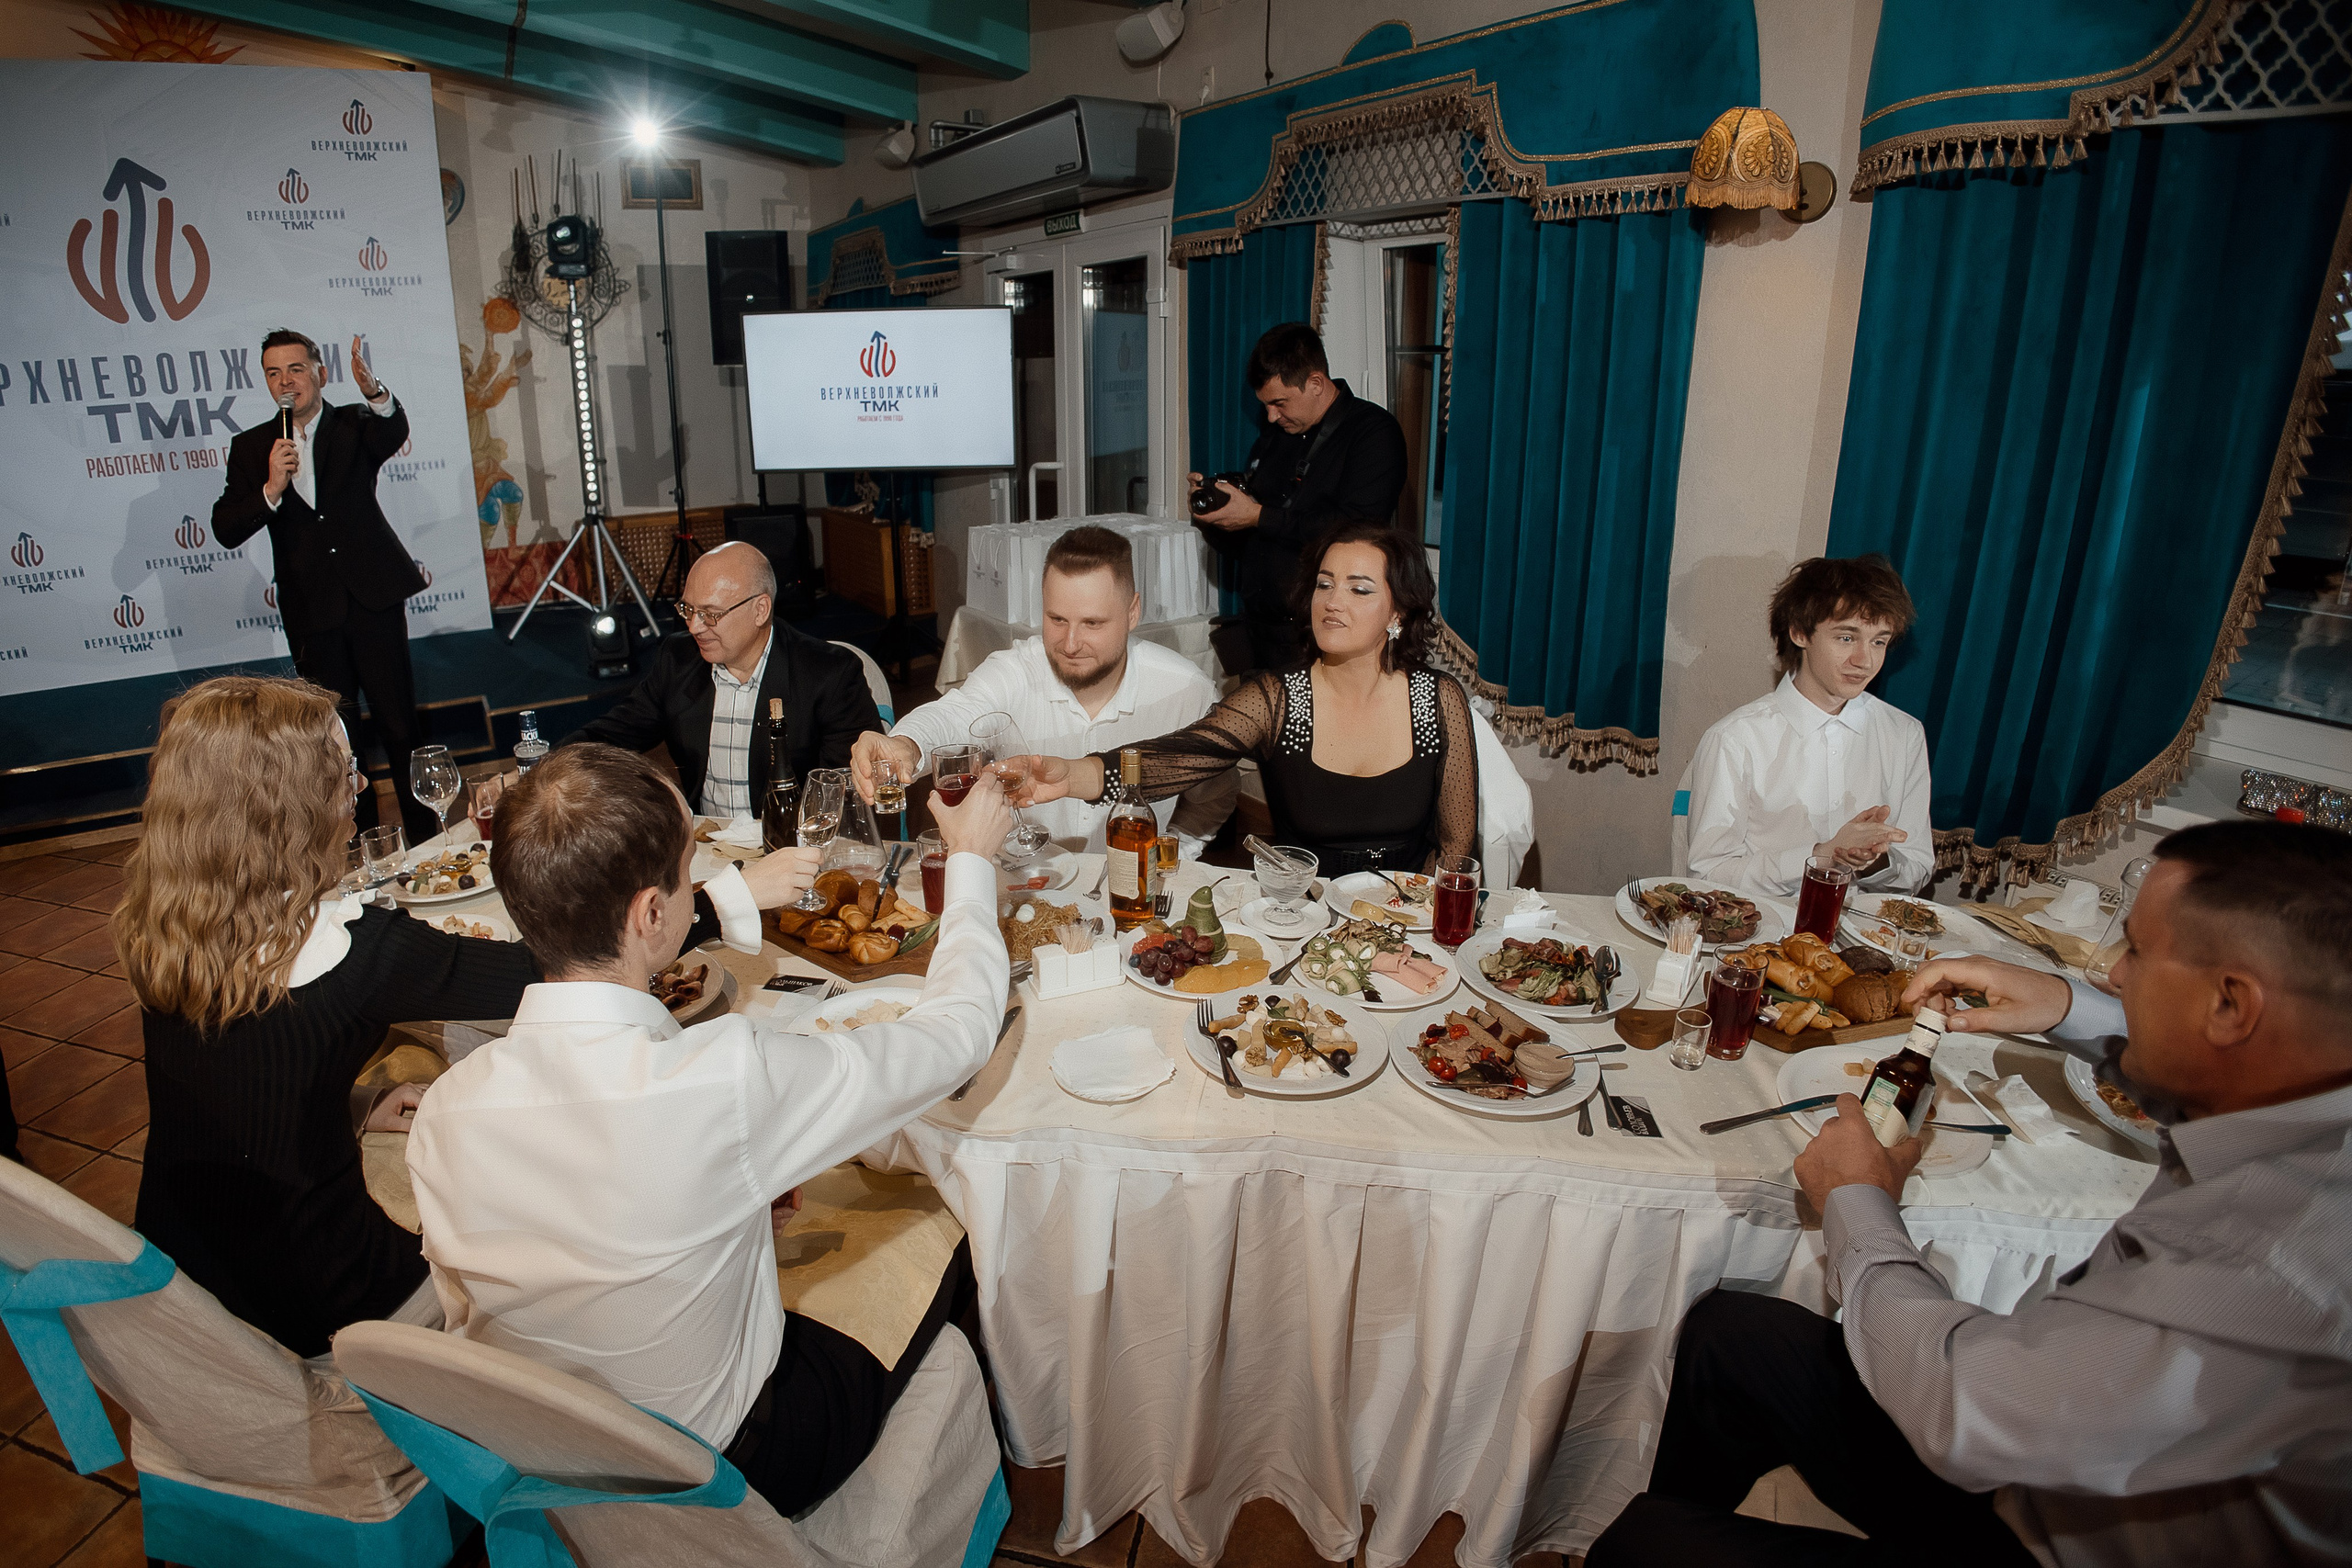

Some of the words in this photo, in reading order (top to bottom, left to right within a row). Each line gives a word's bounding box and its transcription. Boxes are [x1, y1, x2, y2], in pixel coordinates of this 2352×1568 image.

[311, 140, 408, 152] ВЕРХНЕВОЛЖСКИЙ
[345, 152, 378, 161] ТМК
[246, 208, 345, 220] ВЕРХНЕВОЛЖСКИЙ
[281, 220, 314, 231] ТМК
[1046, 215, 1078, 232] ВЫХОД
[361, 287, 393, 296] ТМК
[0, 333, 373, 406] РХНЕВОЛЖИ
[820, 382, 938, 400] ВЕРХНЕВОЛЖСКИЙ
[860, 400, 899, 412] ТМК
[86, 395, 243, 444] ТМК
[85, 451, 166, 479] РАБОТАЕМ
[168, 451, 179, 471] С
[183, 448, 219, 469] 1990
[145, 548, 243, 570] ВЕРХНЕВОЛЖСКИЙ
[180, 563, 214, 575] ТМК
[3, 566, 85, 587] ХНЕВОЛЖСКИЙ
[17, 581, 54, 594] ТМК
[84, 626, 184, 649] ВЕРХНЕВОЛЖСКИЙ
[119, 641, 153, 654] ТМК
